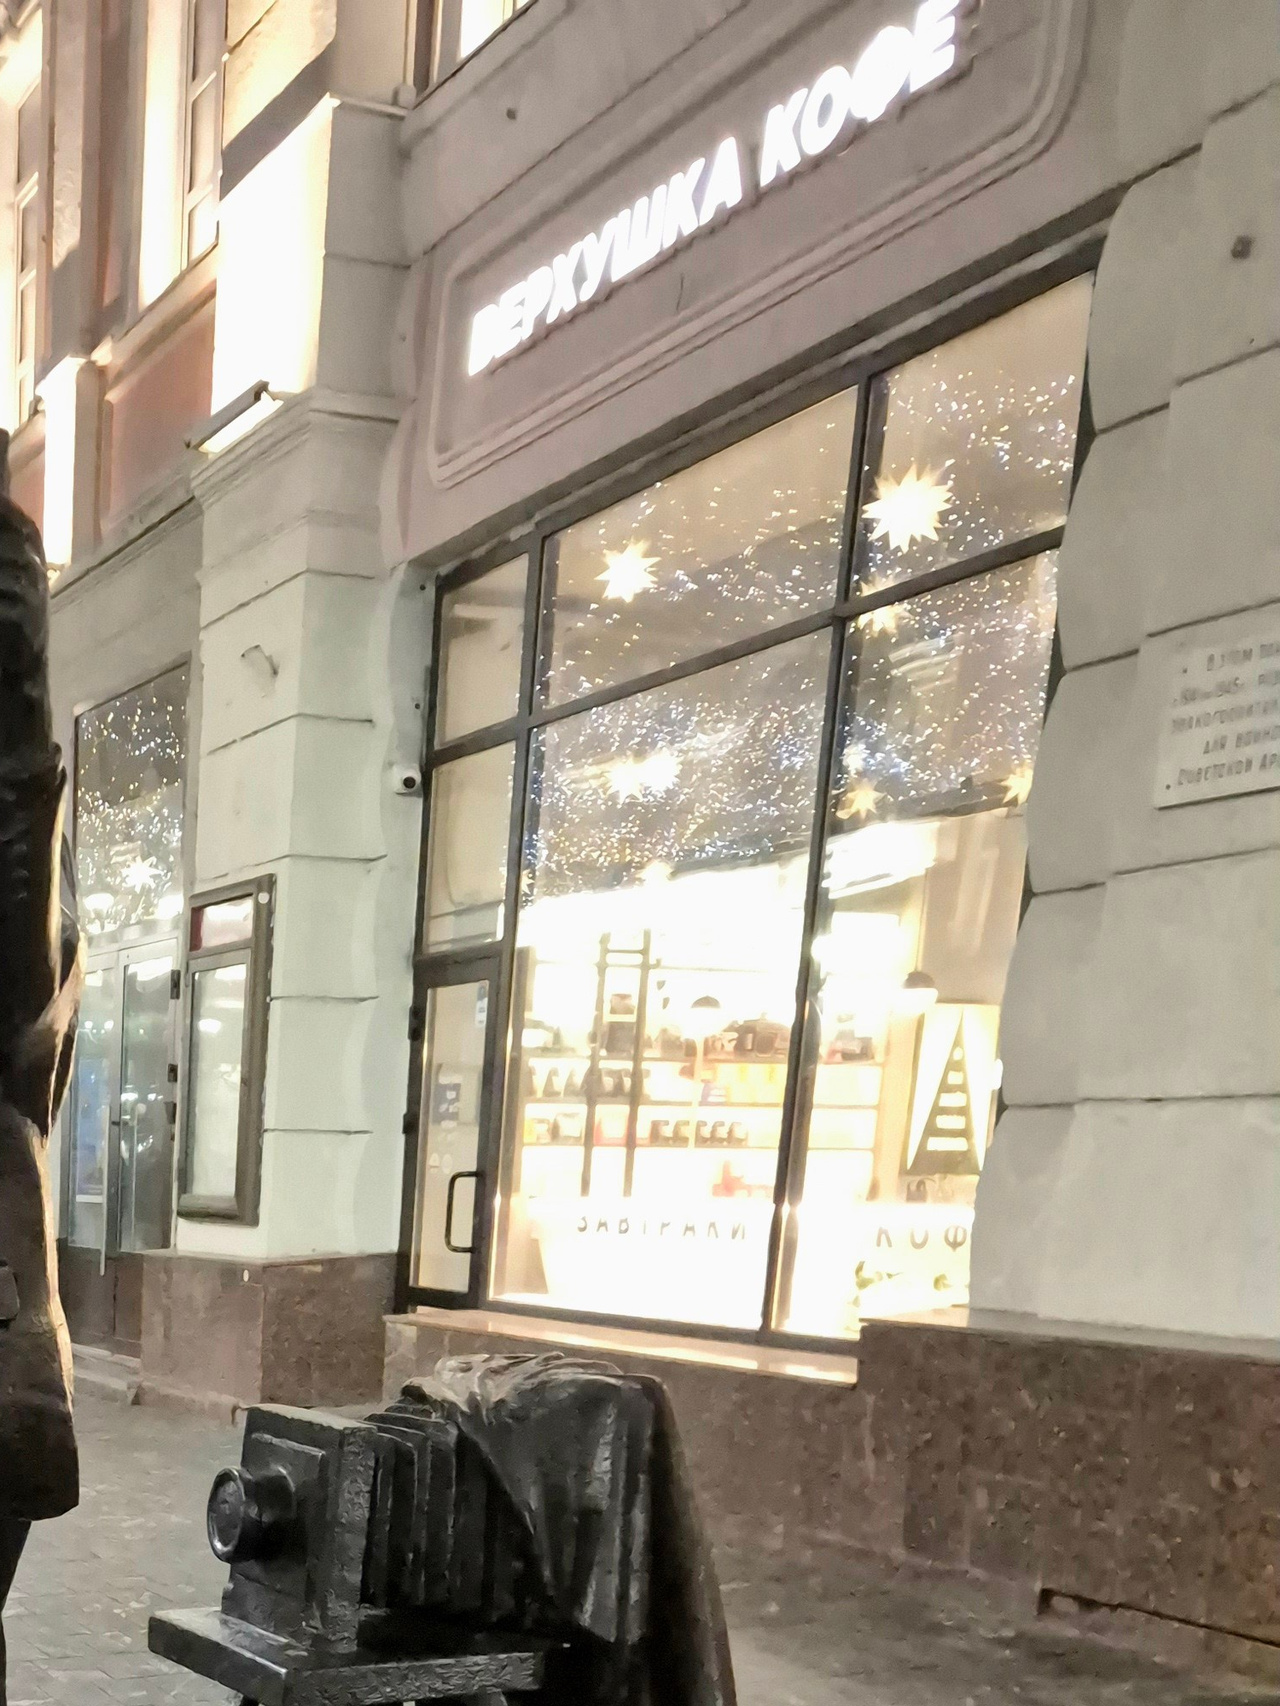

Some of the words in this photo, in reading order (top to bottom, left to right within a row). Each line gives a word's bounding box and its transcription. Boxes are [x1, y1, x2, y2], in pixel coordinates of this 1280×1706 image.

[469, 136, 743, 377] ВЕРХУШКА
[760, 0, 960, 188] КОФЕ
[875, 1223, 969, 1253] КОФ
